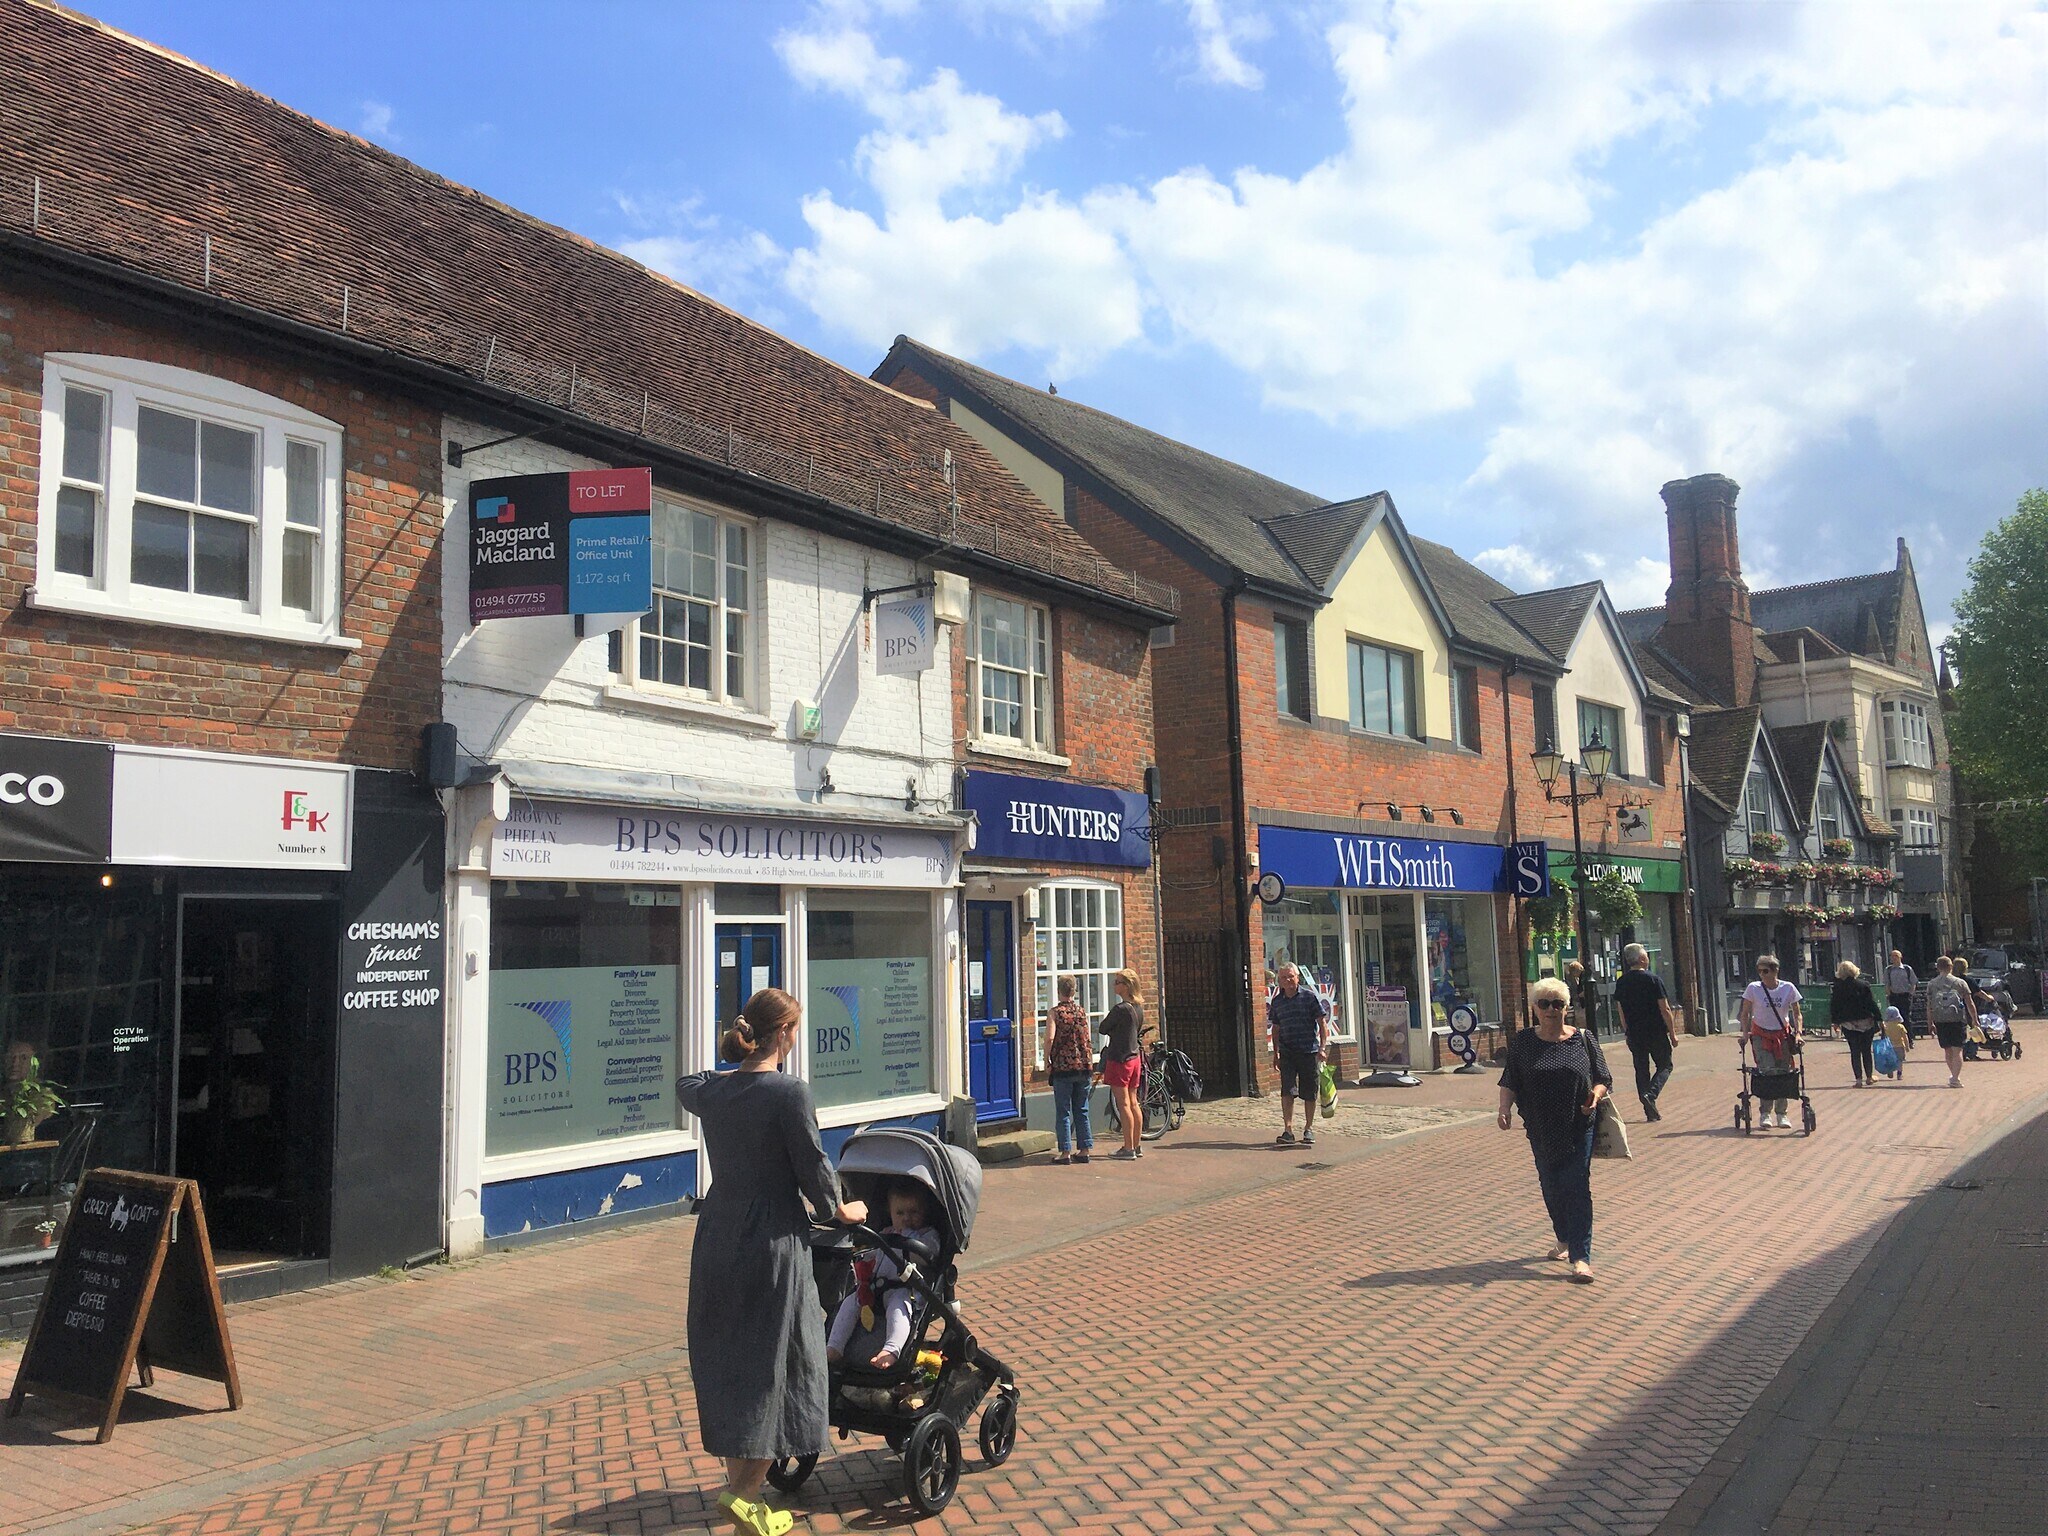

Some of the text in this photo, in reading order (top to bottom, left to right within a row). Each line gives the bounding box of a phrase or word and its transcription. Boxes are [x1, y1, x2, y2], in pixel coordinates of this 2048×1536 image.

[577, 485, 625, 499] TO LET
[476, 522, 550, 547] Jaggard
[576, 537, 607, 547] Prime
[476, 542, 555, 565] Macland
[576, 550, 633, 560] Office Unit
[576, 571, 631, 584] 1,172 sq ft
[475, 593, 545, 608] 01494 677755
[885, 636, 917, 657] BPS
[0, 772, 65, 806] CO
[505, 809, 562, 825] BROWNE
[1006, 801, 1120, 843] HUNTERS
[505, 828, 556, 844] PHELAN
[615, 816, 883, 864] BPS SOLICITORS
[277, 843, 326, 855] Number 8
[502, 849, 551, 863] SINGER
[1516, 846, 1539, 856] WH
[610, 860, 635, 871] 01494
[637, 861, 664, 872] 782244
[673, 864, 753, 875] www.bpssolicitors.co.uk
[772, 867, 786, 878] High
[788, 868, 808, 877] Street,
[926, 857, 945, 873] BPS
[1333, 838, 1455, 888] WHSmith
[1518, 857, 1542, 894] S
[1620, 865, 1644, 884] BANK
[348, 921, 440, 940] CHESHAM'S
[365, 944, 422, 966] finest
[356, 969, 430, 984] INDEPENDENT
[614, 970, 656, 979] Family Law
[344, 988, 440, 1010] COFFEE SHOP
[113, 1027, 144, 1036] CCTV In
[113, 1034, 149, 1045] Operation
[113, 1044, 130, 1052] Here
[816, 1026, 851, 1054] BPS
[504, 1050, 557, 1086] BPS
[607, 1055, 662, 1066] Conveyancing
[503, 1091, 571, 1104] SOLICITORS
[608, 1092, 660, 1105] Private Client
[83, 1198, 112, 1216] CRAZY
[130, 1204, 153, 1223] GOAT
[79, 1291, 107, 1310] COFFEE
